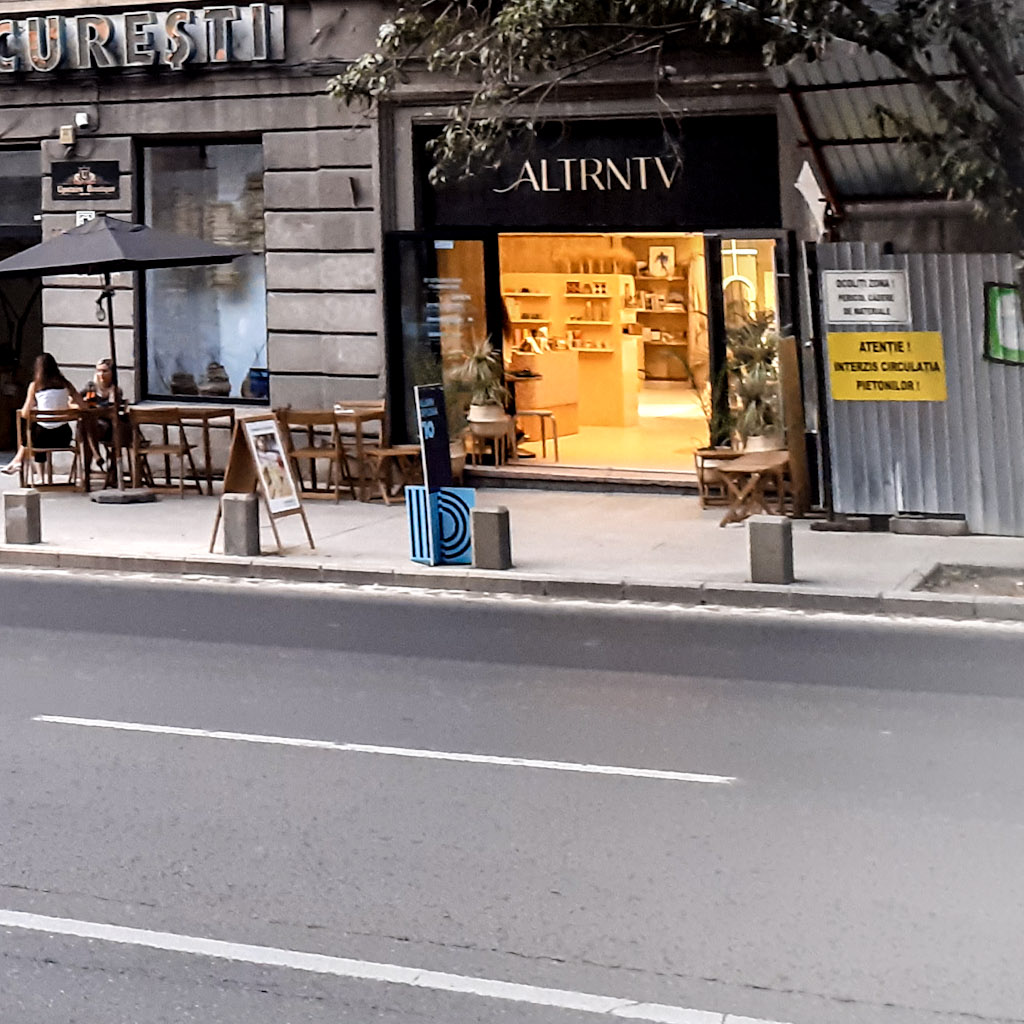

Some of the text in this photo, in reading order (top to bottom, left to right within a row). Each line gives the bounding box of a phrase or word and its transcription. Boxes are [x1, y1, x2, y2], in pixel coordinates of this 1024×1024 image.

[493, 156, 680, 193] ALTRNTV
[859, 341, 905, 355] ATENȚIE
[834, 361, 878, 372] INTERZIS
[856, 380, 914, 391] PIETONILOR
